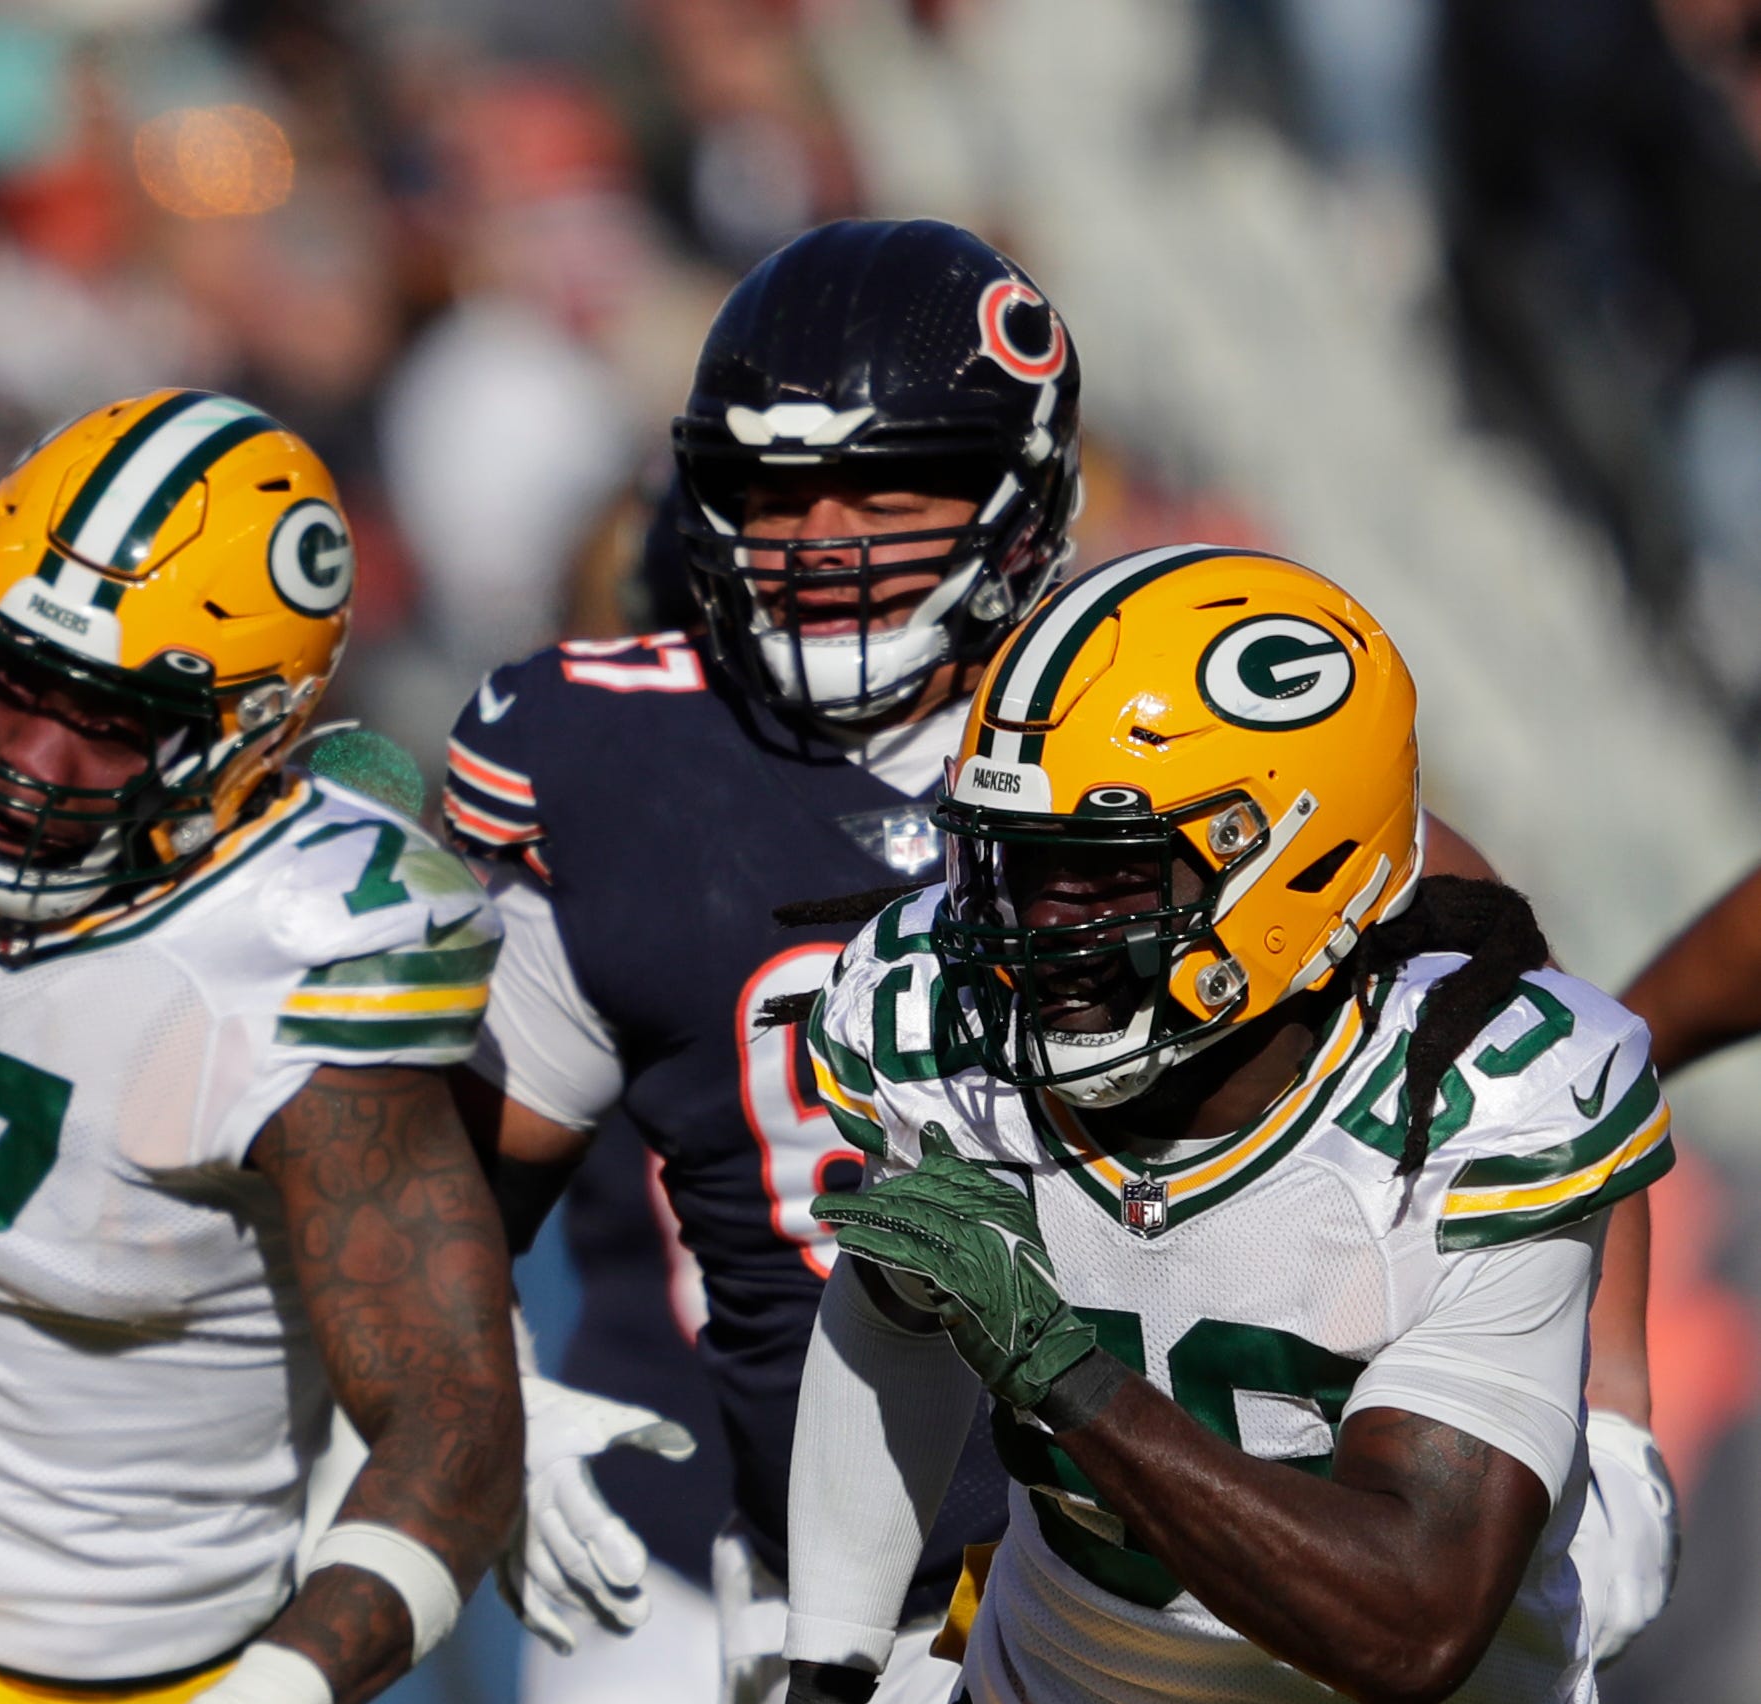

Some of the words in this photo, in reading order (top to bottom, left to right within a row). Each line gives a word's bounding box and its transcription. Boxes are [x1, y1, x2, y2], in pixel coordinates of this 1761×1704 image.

[977, 278, 1067, 384] C
[270, 503, 354, 611] G
[28, 592, 91, 636] PACKERS
[1202, 617, 1352, 725] G
[972, 767, 1021, 795] PACKERS
[296, 819, 413, 917] 7
[1125, 1200, 1162, 1227] NFL
